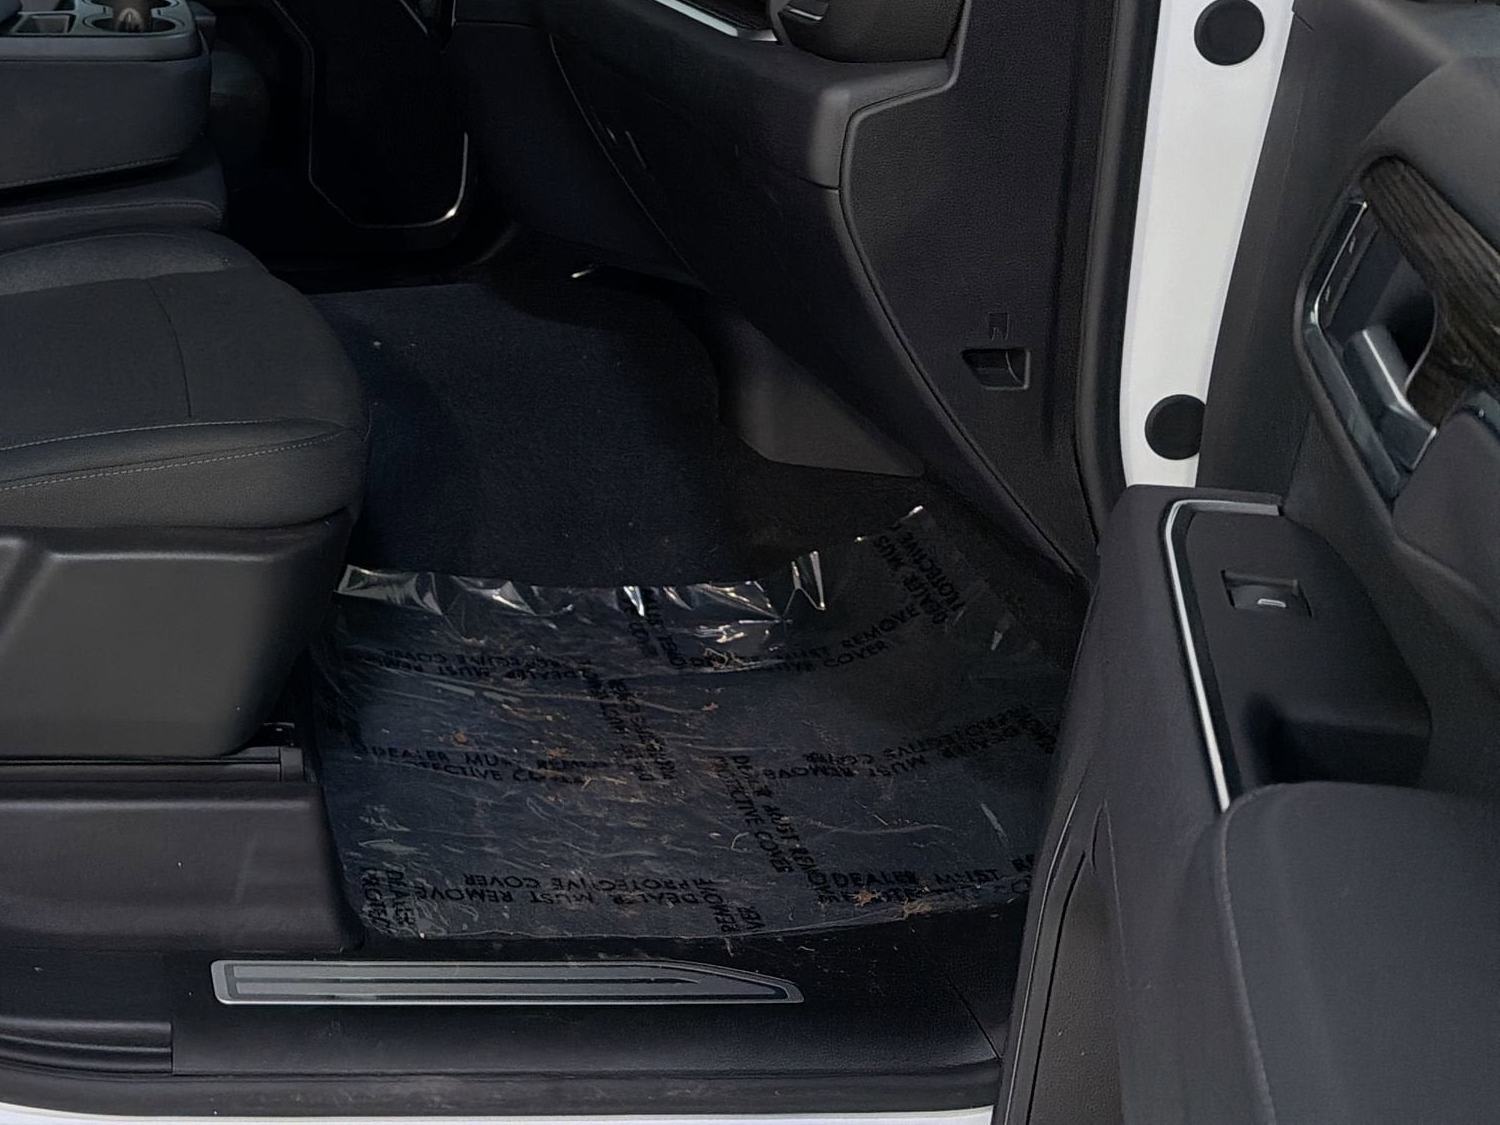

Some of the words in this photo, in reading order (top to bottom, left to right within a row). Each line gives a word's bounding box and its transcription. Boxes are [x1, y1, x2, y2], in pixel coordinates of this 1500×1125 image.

[870, 534, 904, 571] MUS
[842, 606, 920, 648] REMOVE
[824, 639, 889, 667] COVER
[763, 765, 855, 779] REMOVE
[869, 755, 926, 778] MUST
[758, 828, 793, 875] COVER
[463, 874, 541, 889] COVER
[414, 887, 512, 903] REMOVE
[530, 893, 593, 904] MUST
